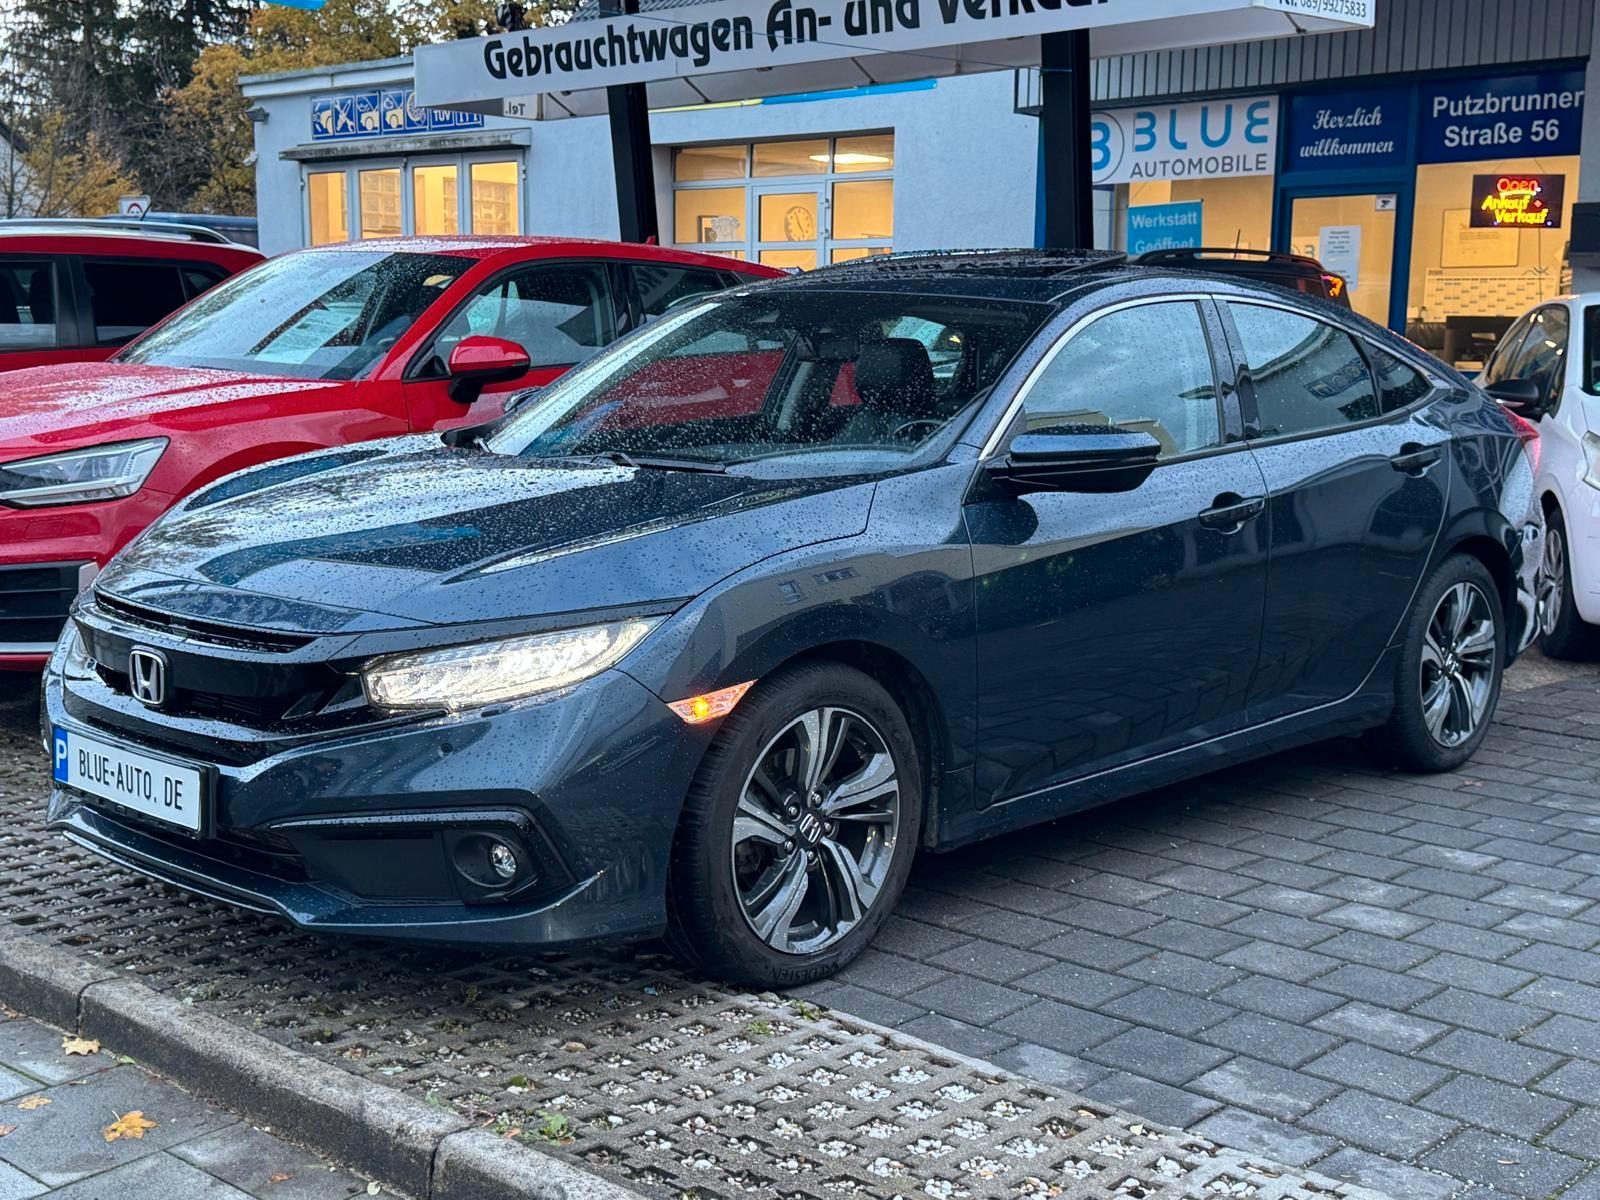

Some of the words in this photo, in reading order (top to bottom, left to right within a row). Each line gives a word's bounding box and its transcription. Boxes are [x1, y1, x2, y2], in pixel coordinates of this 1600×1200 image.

[484, 16, 753, 79] Gebrauchtwagen
[766, 0, 832, 52] An-
[844, 0, 921, 36] und
[1432, 90, 1585, 118] Putzbrunner
[1134, 100, 1270, 152] BLUE
[1312, 106, 1383, 130] Herzlich
[1443, 121, 1523, 148] Straße
[1530, 119, 1560, 142] 56
[1299, 137, 1395, 158] willkommen
[1129, 153, 1268, 179] AUTOMOBILE
[1481, 194, 1531, 210] Ankauf
[1131, 211, 1198, 229] Werkstatt
[1494, 208, 1549, 224] Verkauf
[55, 739, 67, 770] P
